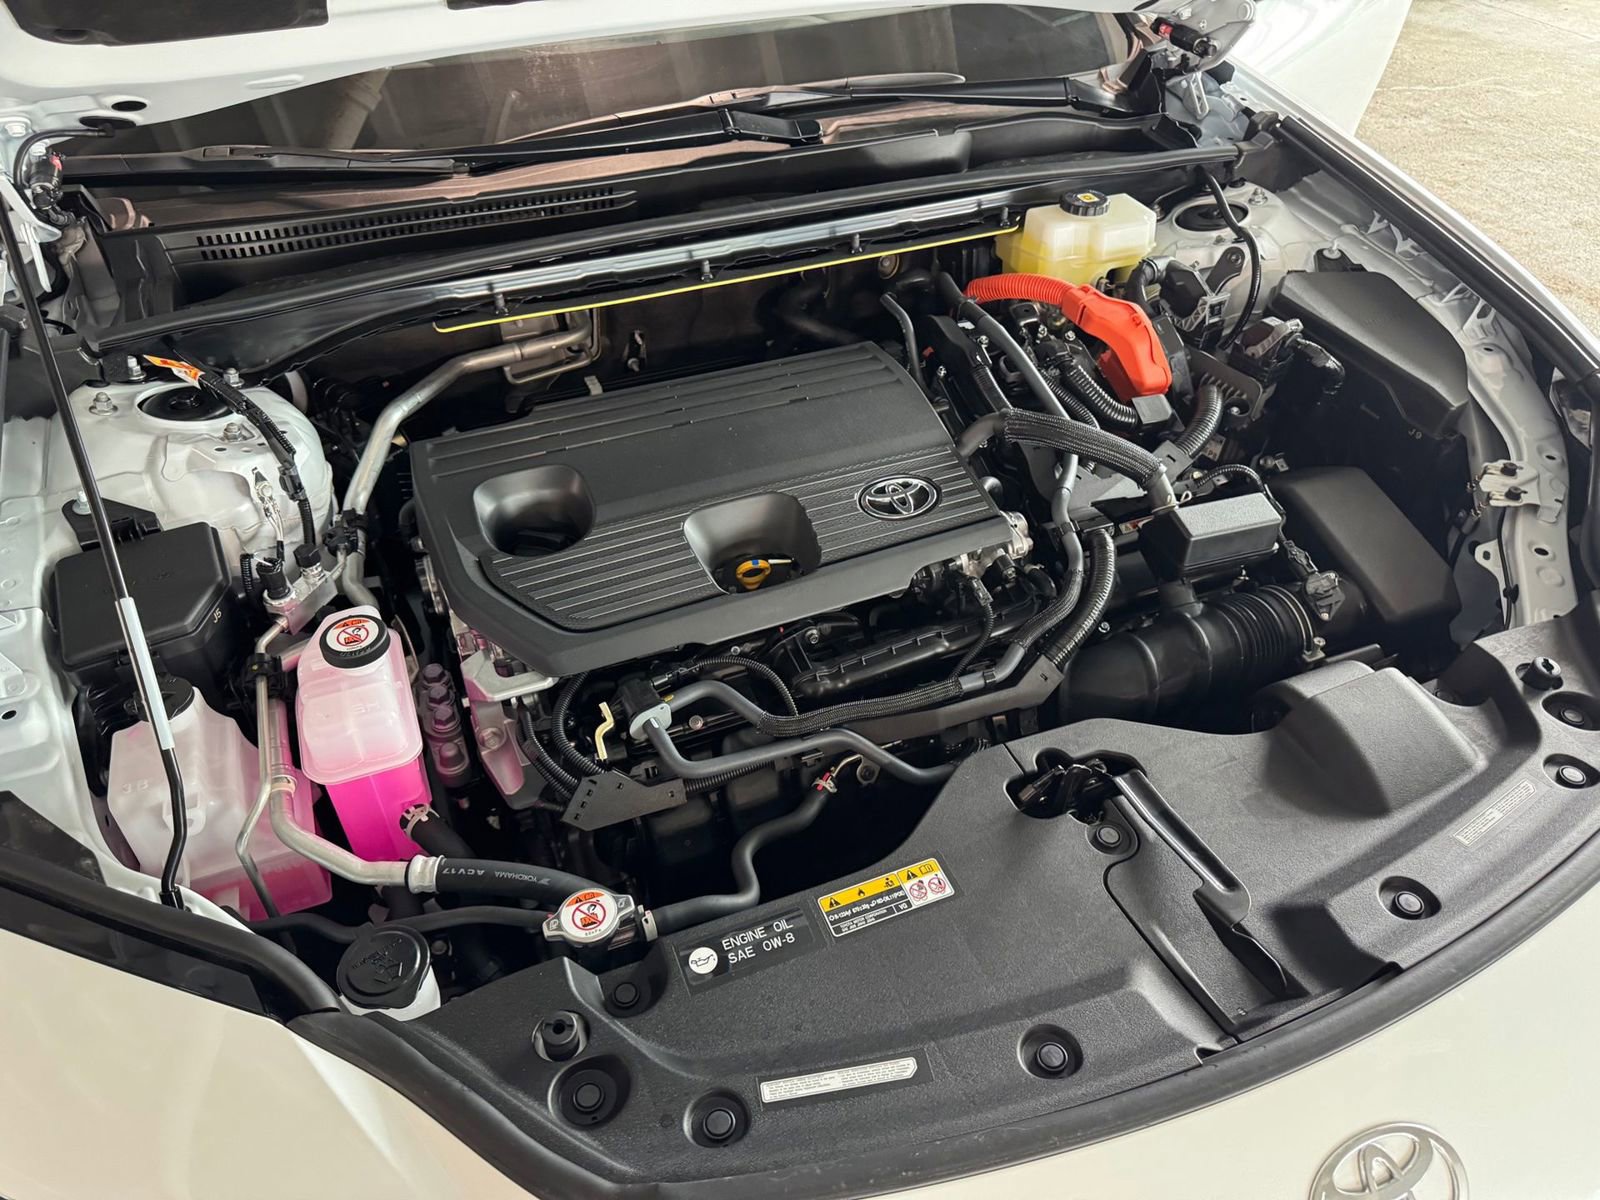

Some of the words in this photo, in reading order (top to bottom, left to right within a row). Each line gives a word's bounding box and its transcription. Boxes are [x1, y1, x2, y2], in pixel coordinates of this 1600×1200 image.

[213, 607, 222, 624] J5
[442, 867, 485, 876] ACV17
[494, 871, 538, 882] YOKOHAMA
[721, 926, 768, 951] ENGINE
[773, 918, 794, 932] OIL
[727, 945, 756, 964] SAE
[762, 932, 796, 951] 0W-8
